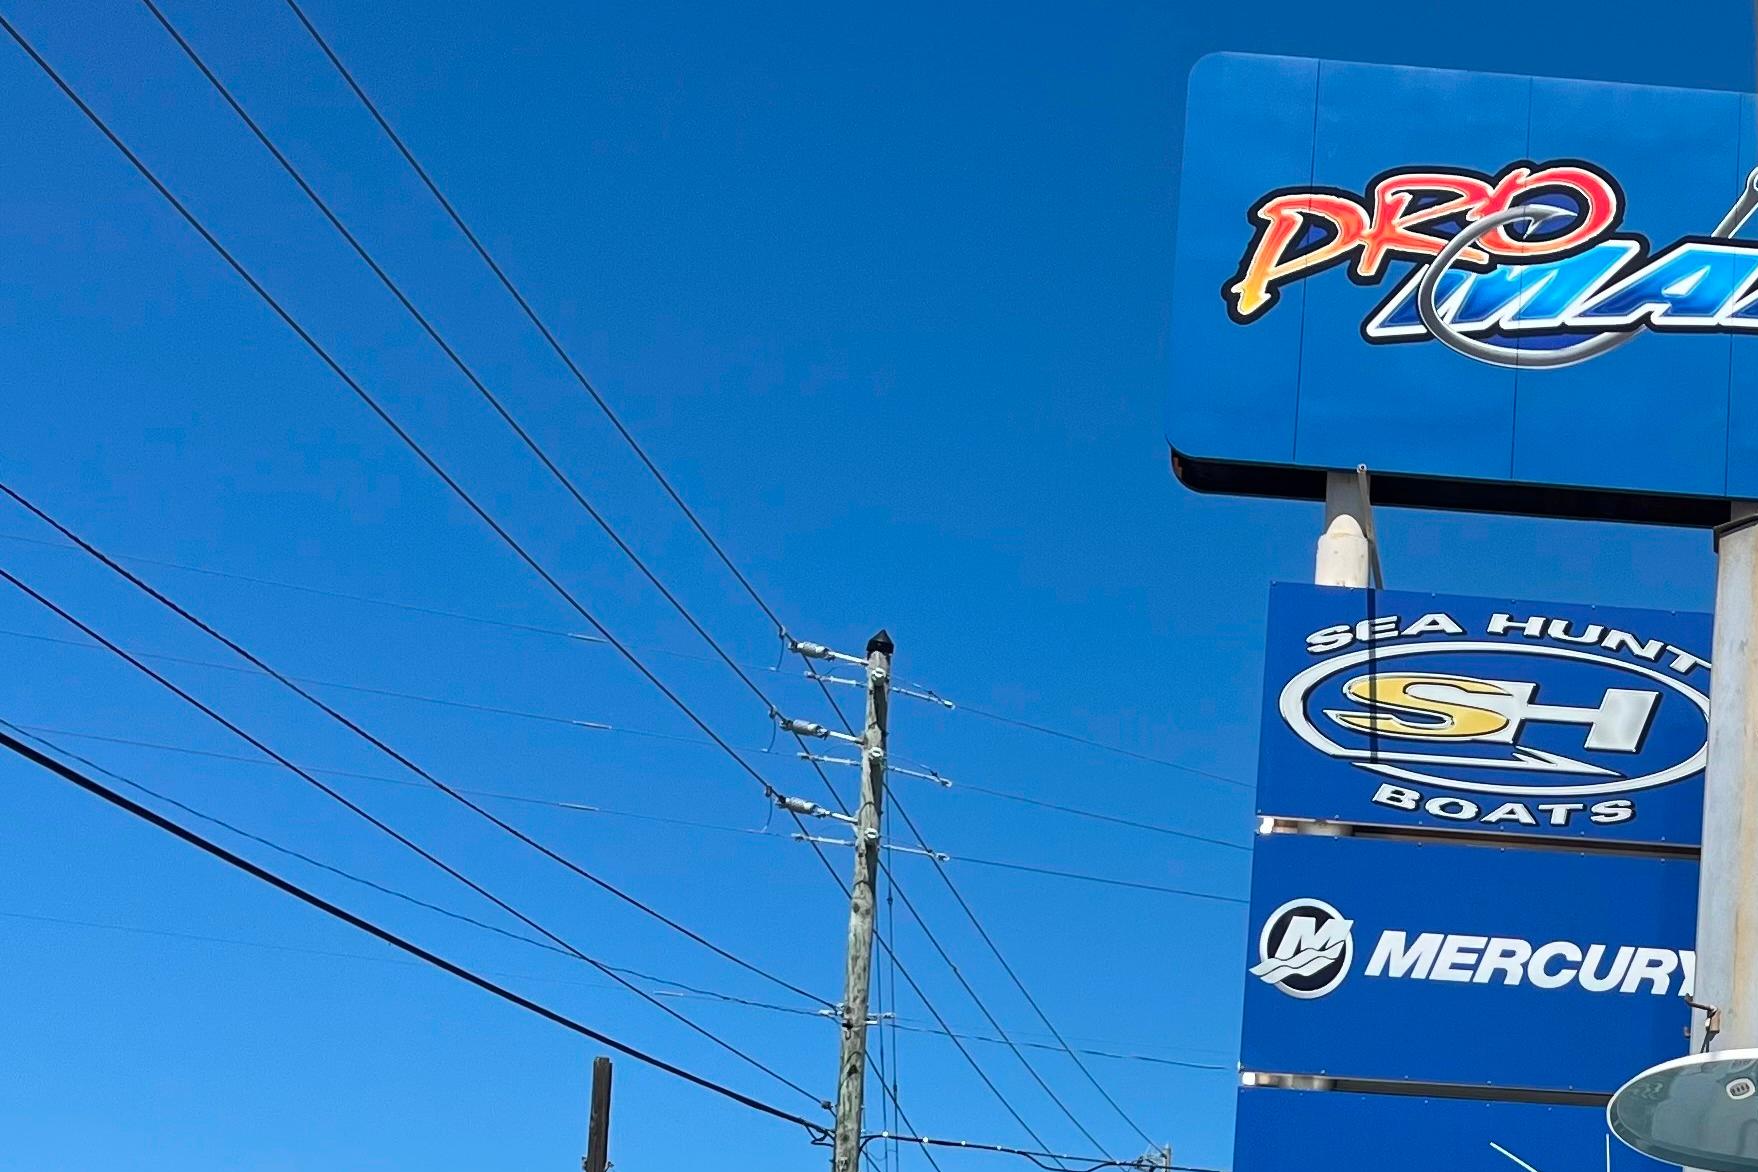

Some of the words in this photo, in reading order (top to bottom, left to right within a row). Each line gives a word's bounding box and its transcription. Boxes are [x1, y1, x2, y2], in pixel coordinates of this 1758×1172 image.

[1228, 164, 1619, 318] PRO
[1306, 612, 1463, 653] SEA
[1487, 613, 1712, 673] HUNT
[1323, 672, 1660, 752] SH
[1371, 784, 1635, 826] BOATS
[1364, 930, 1696, 997] MERCURY
